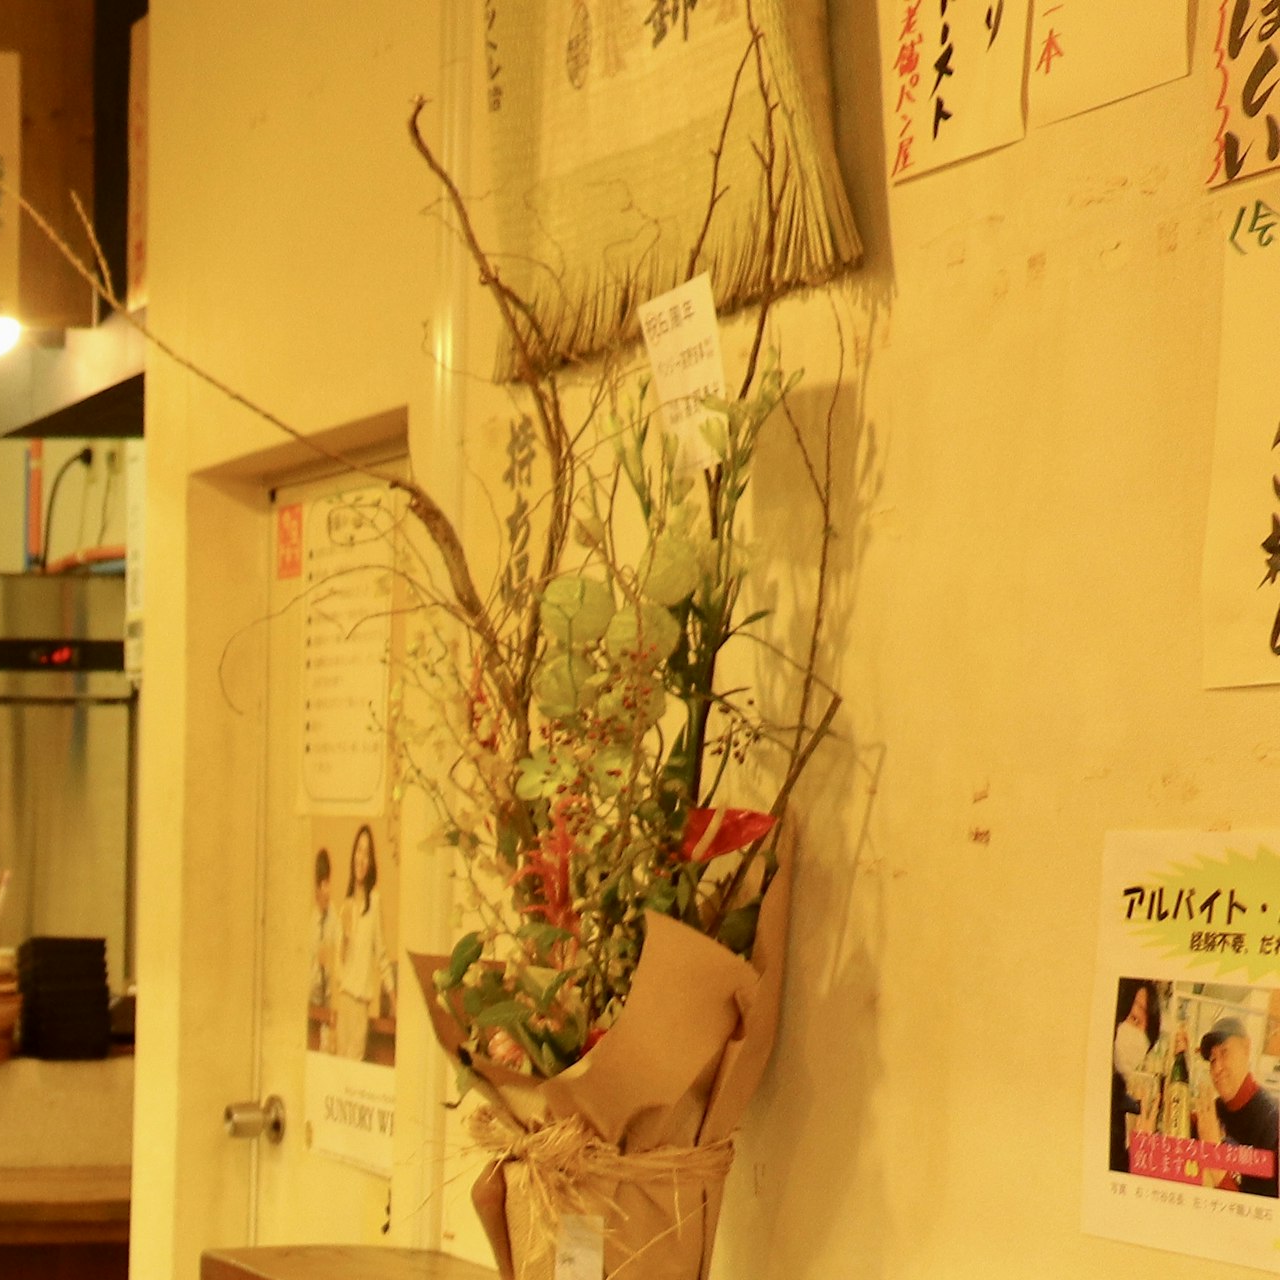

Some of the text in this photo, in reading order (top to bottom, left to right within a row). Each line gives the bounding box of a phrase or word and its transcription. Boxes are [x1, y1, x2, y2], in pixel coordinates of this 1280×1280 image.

[1122, 886, 1280, 926] アルバイト・
